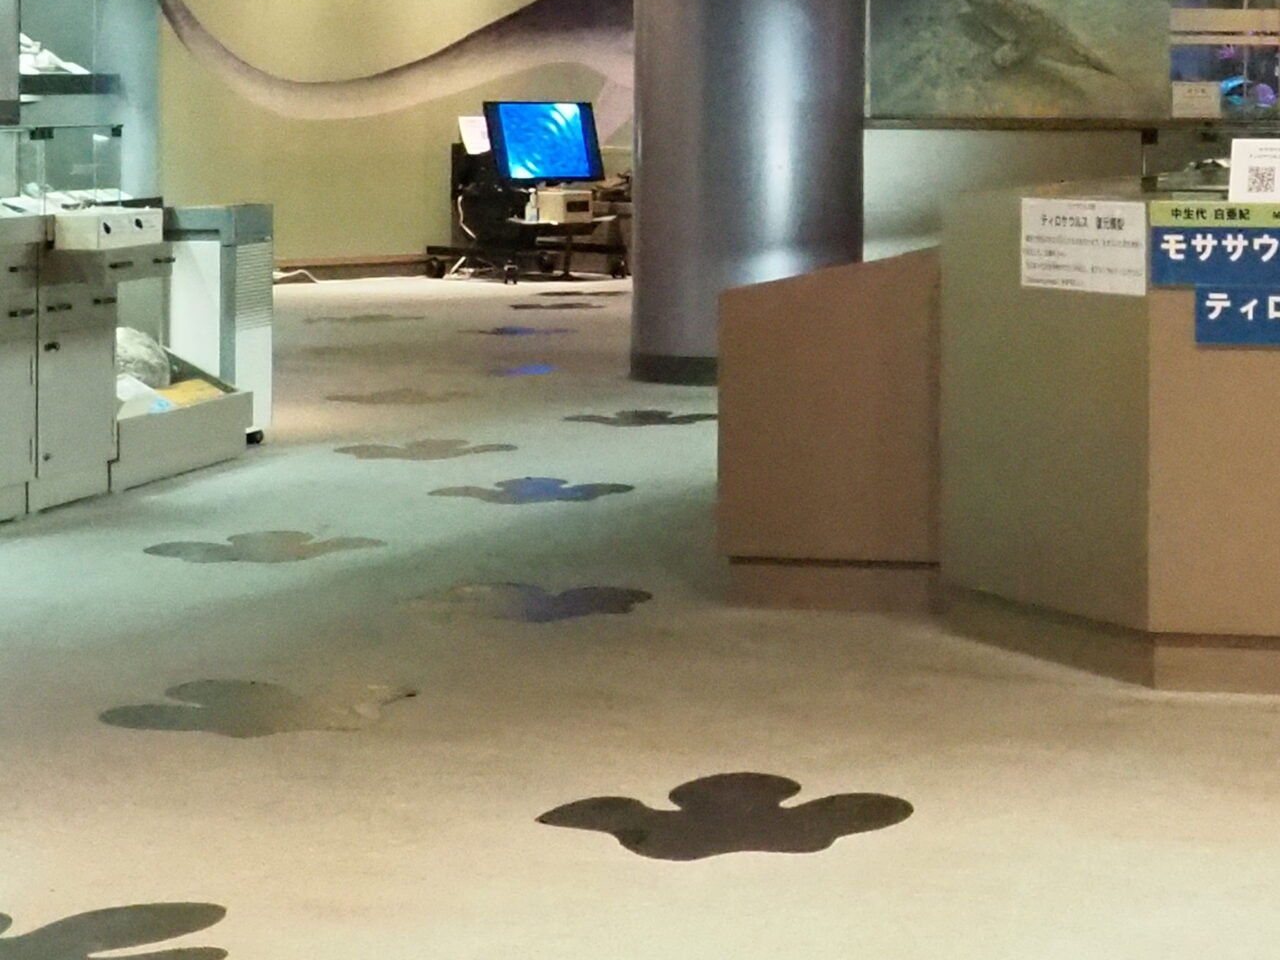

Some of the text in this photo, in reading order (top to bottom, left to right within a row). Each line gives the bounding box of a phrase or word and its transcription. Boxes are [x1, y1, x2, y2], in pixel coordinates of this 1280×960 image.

[1171, 208, 1250, 220] 中生代 白亜紀
